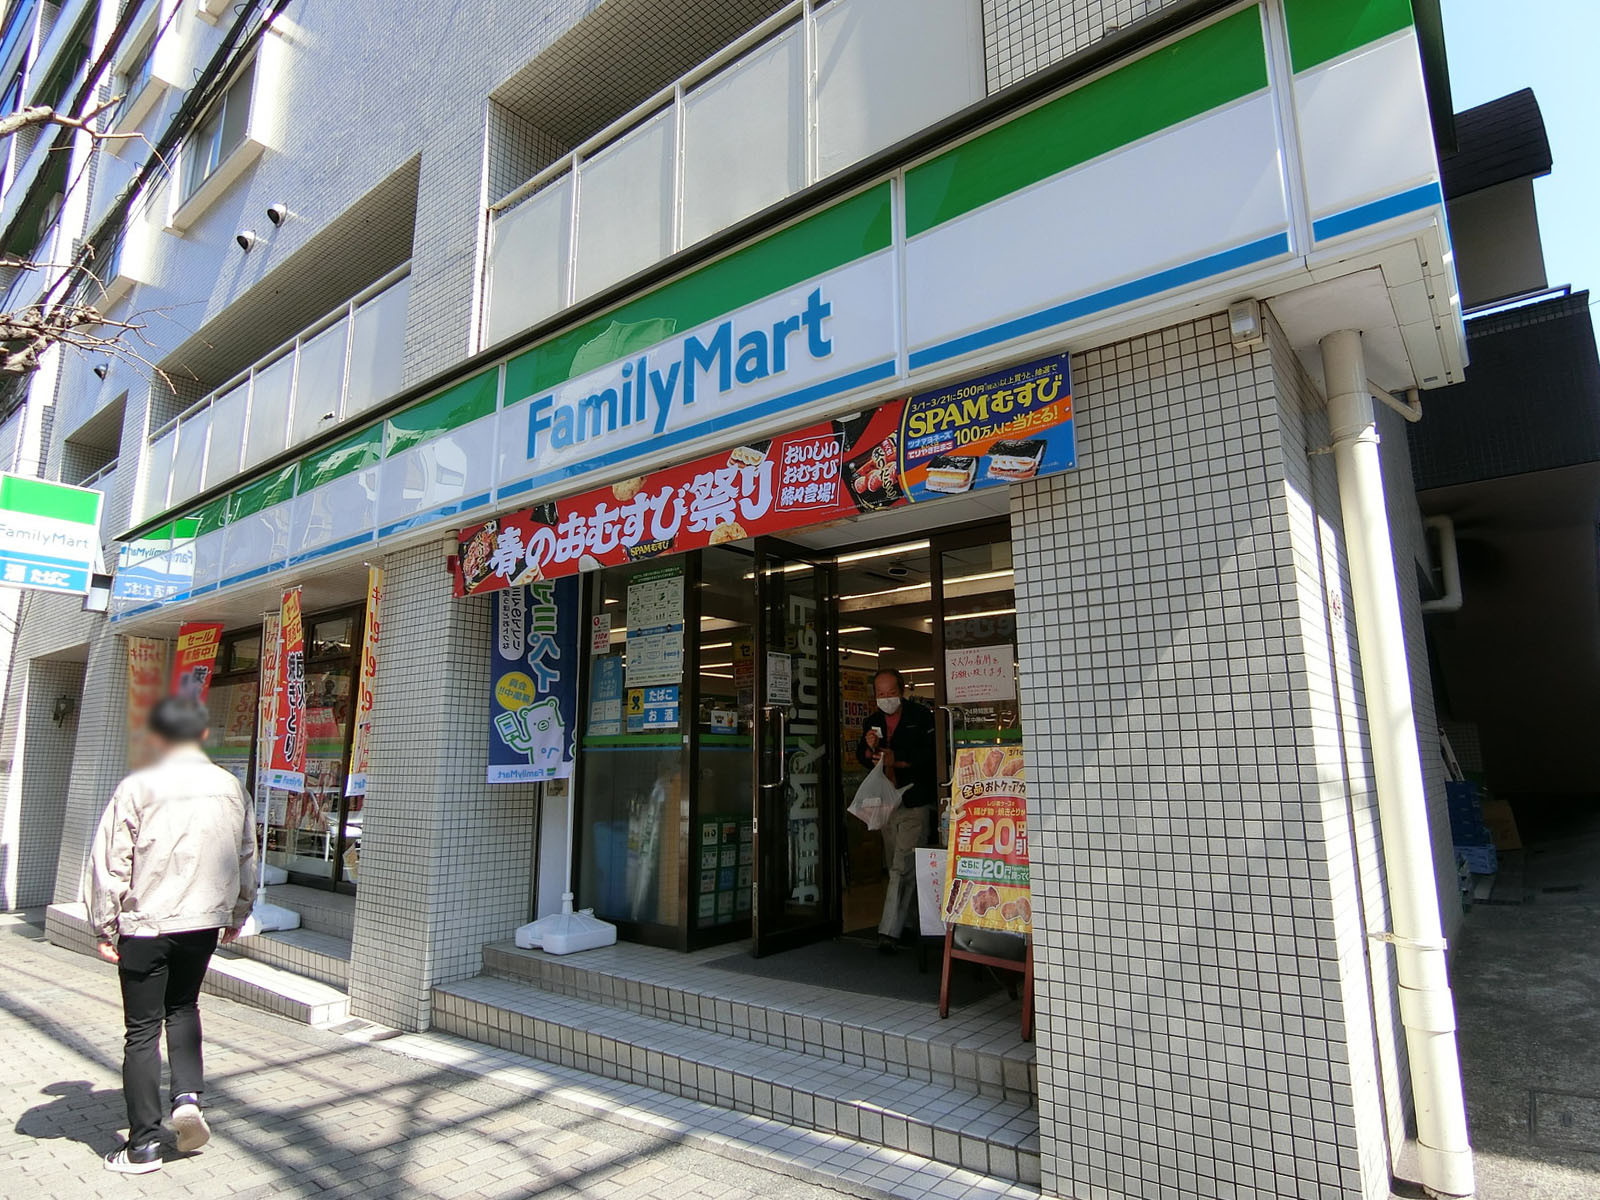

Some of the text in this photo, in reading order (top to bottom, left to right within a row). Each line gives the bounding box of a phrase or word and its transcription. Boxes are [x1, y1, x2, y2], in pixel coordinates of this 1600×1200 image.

[526, 286, 832, 460] FamilyMart
[784, 441, 839, 464] おいしい
[783, 459, 839, 484] おむすび
[489, 459, 774, 578] 春のおむすび祭り
[649, 689, 673, 701] たばこ
[973, 817, 1016, 855] 20
